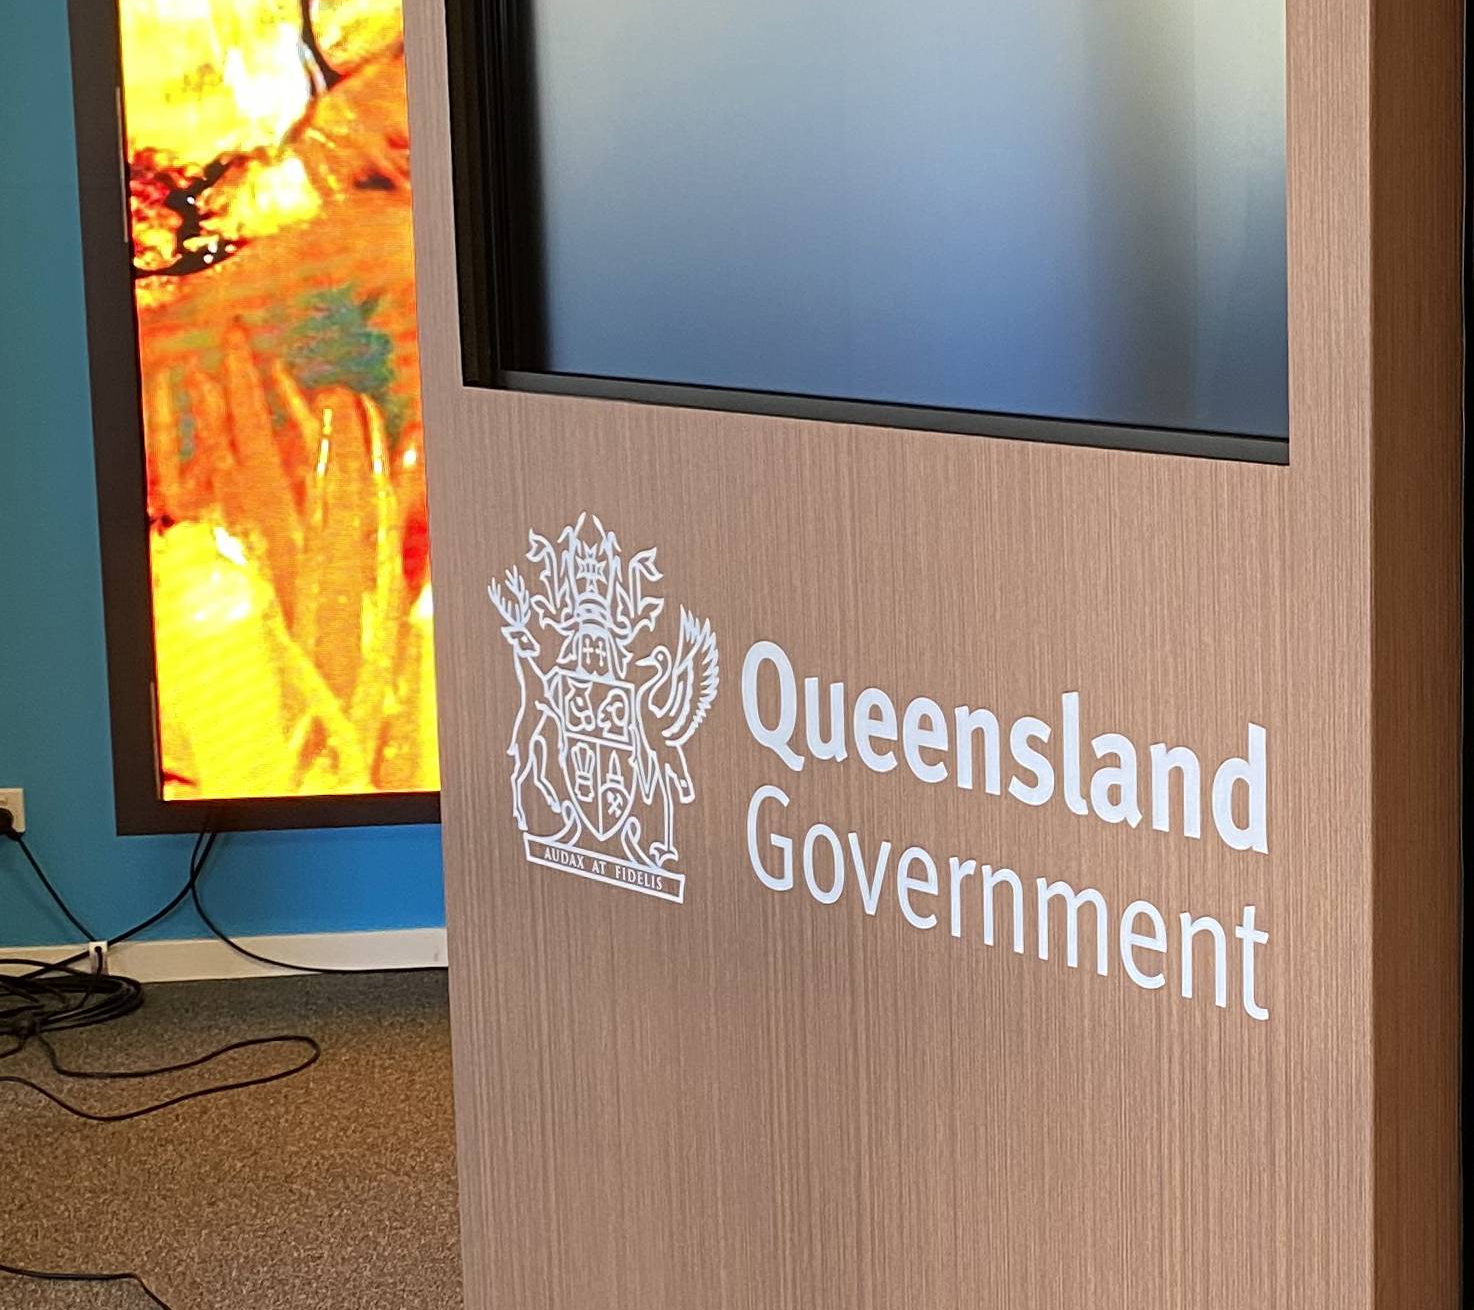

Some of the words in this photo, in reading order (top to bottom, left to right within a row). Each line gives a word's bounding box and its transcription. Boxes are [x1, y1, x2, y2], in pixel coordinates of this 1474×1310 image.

[741, 640, 1269, 855] Queensland
[543, 846, 585, 870] AUDAX
[591, 860, 608, 875] AT
[615, 865, 664, 891] FIDELIS
[747, 784, 1270, 1021] Government
